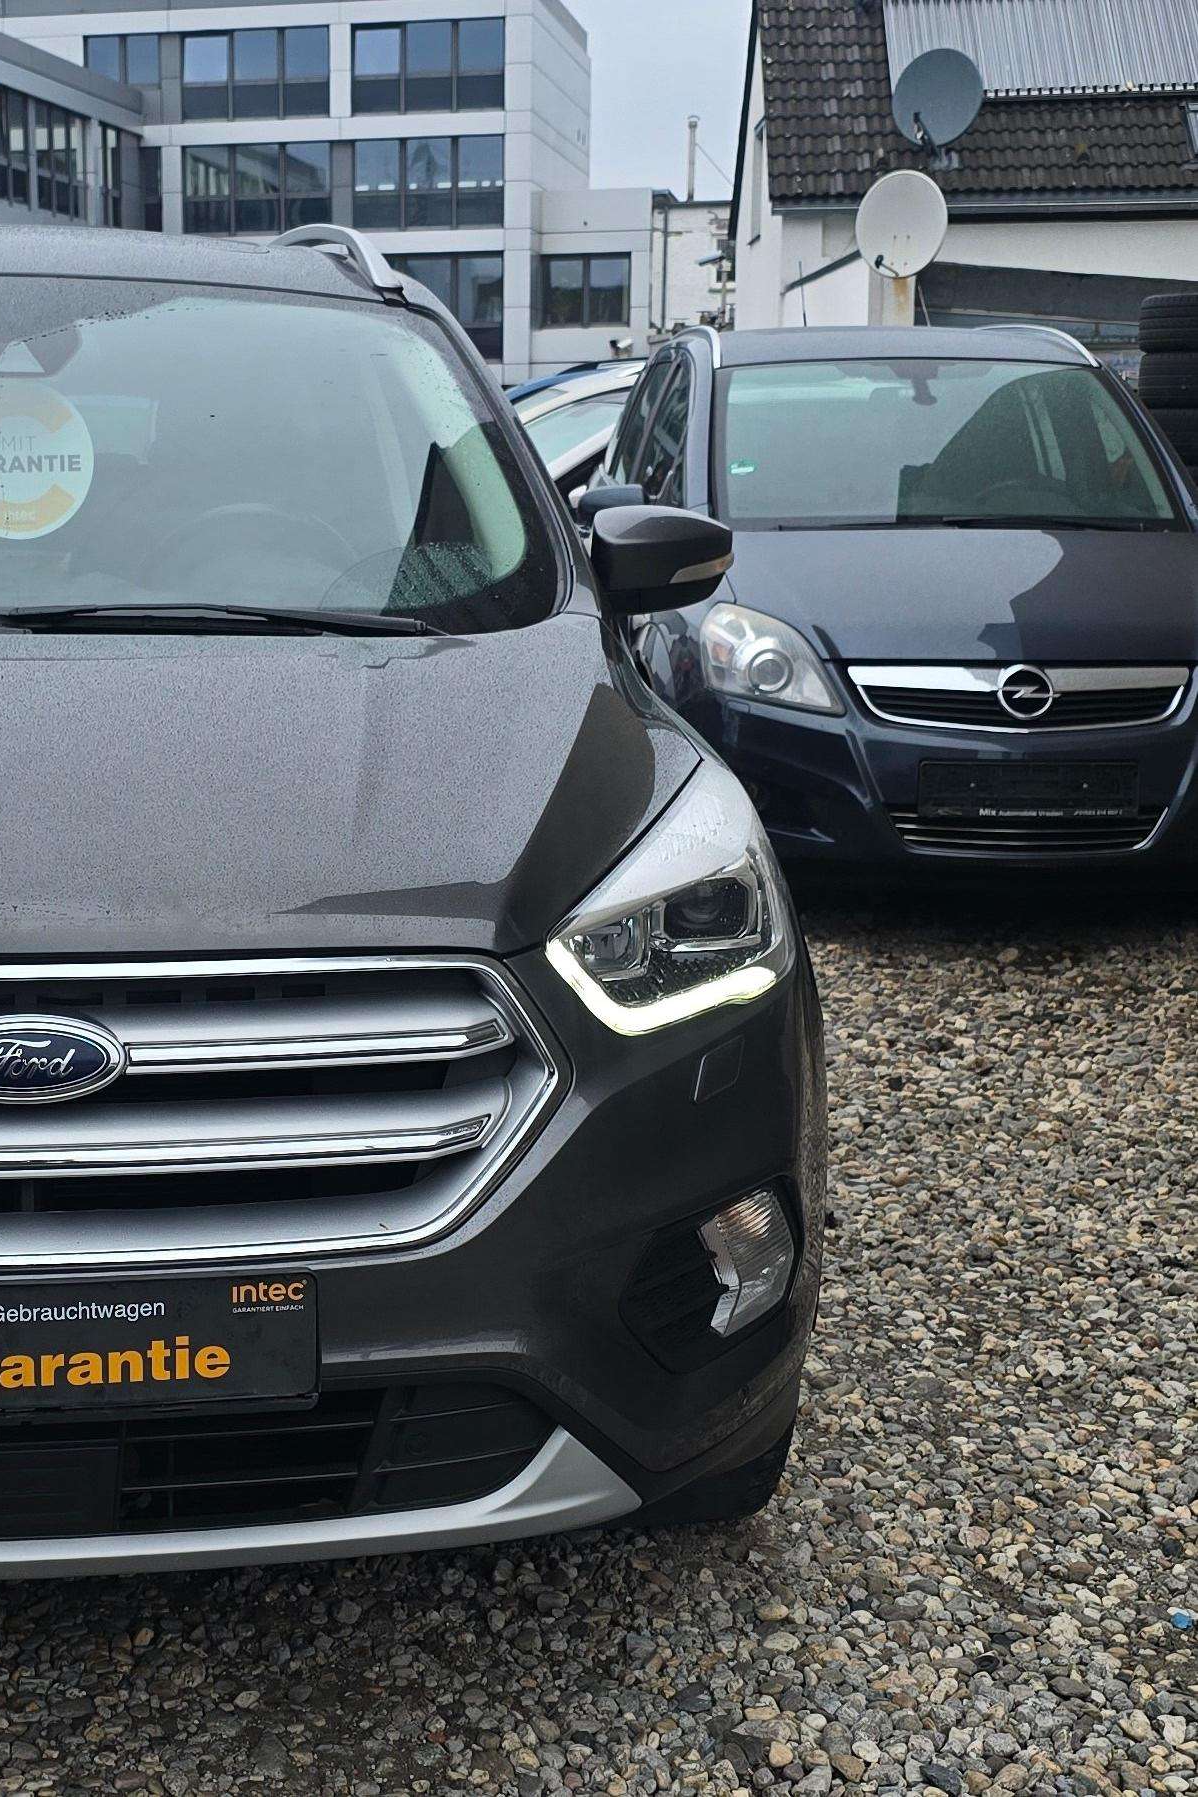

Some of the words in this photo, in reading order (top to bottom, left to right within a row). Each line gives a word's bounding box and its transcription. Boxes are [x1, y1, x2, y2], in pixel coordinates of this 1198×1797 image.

[0, 435, 36, 452] MIT
[232, 1281, 304, 1303] intec
[232, 1305, 275, 1313] GARANTIERT
[275, 1304, 304, 1312] EINFACH
